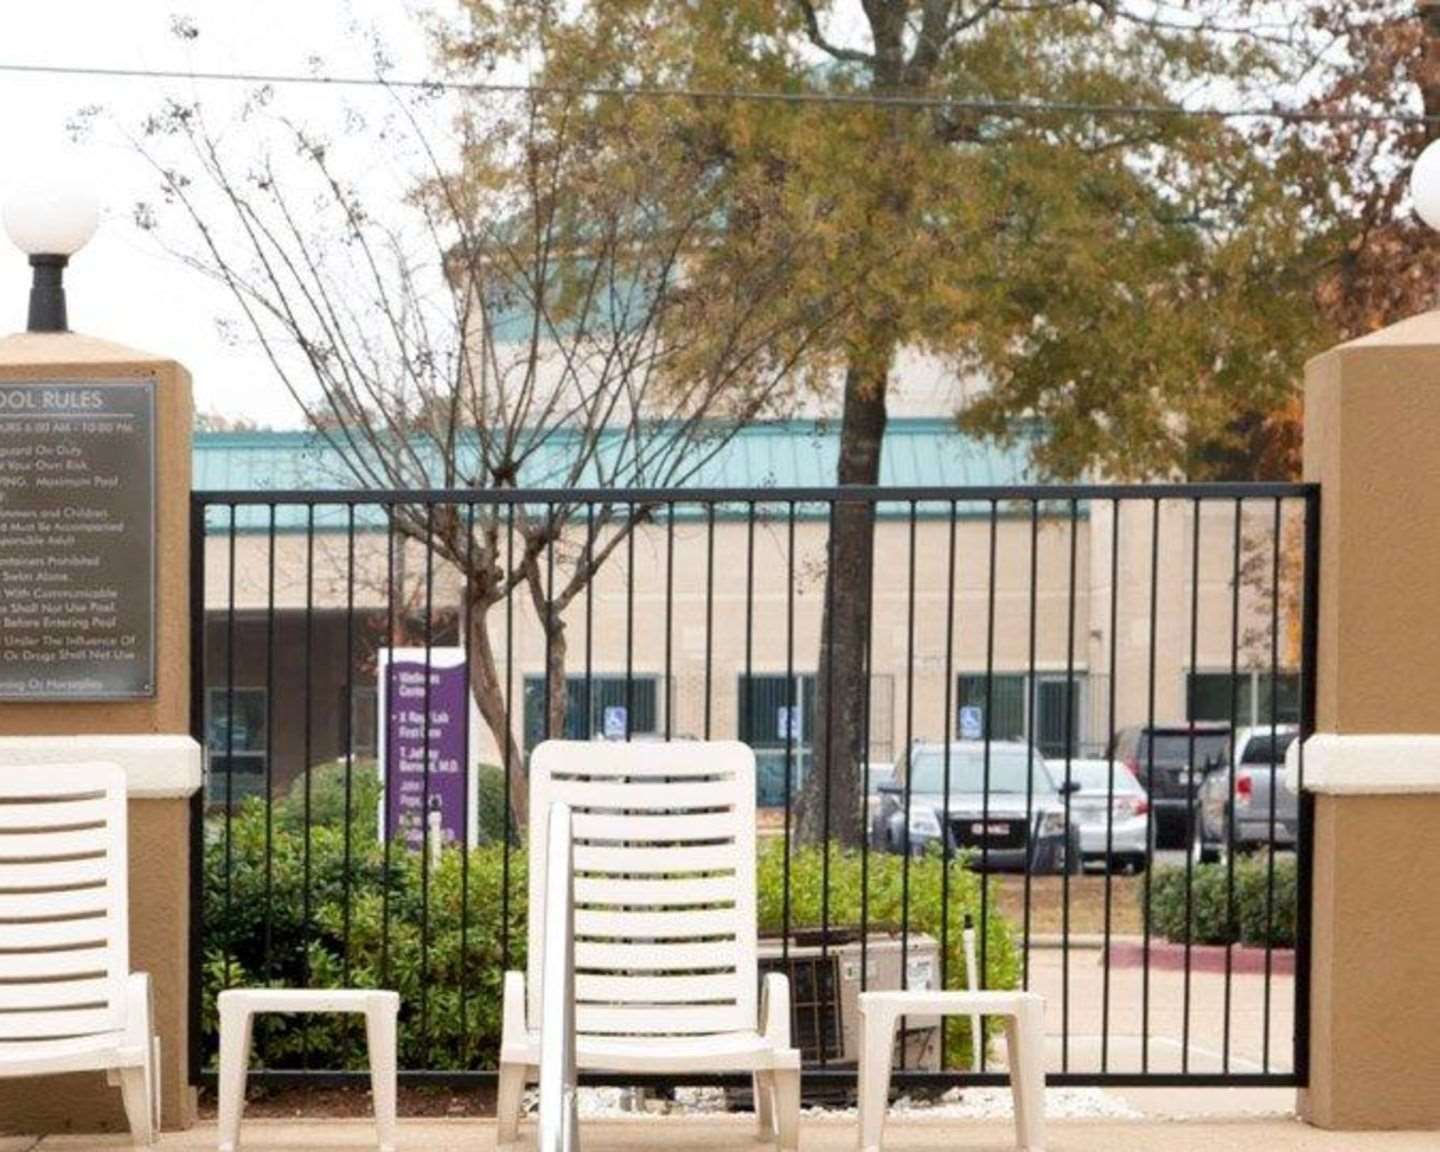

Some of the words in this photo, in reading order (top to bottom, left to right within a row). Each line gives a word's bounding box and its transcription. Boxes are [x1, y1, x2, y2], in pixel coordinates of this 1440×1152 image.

[43, 390, 103, 409] RULES
[35, 445, 53, 456] On
[35, 460, 61, 471] Own
[35, 475, 91, 487] Maximum
[93, 475, 119, 487] Pool
[63, 507, 108, 518] Children
[3, 571, 33, 582] Swim
[3, 587, 31, 598] With
[33, 587, 118, 598] Communicable
[10, 602, 39, 613] Shall
[41, 602, 63, 613] Not
[65, 602, 87, 613] Use
[3, 617, 40, 629] Before
[43, 617, 90, 629] Entering
[4, 635, 40, 647] Under
[42, 635, 62, 647] The
[66, 635, 117, 647] Influence
[120, 635, 136, 647] Of
[3, 650, 19, 662] Or
[22, 650, 56, 662] Drugs
[59, 650, 86, 662] Shall
[88, 650, 111, 662] Not
[113, 650, 136, 662] Use
